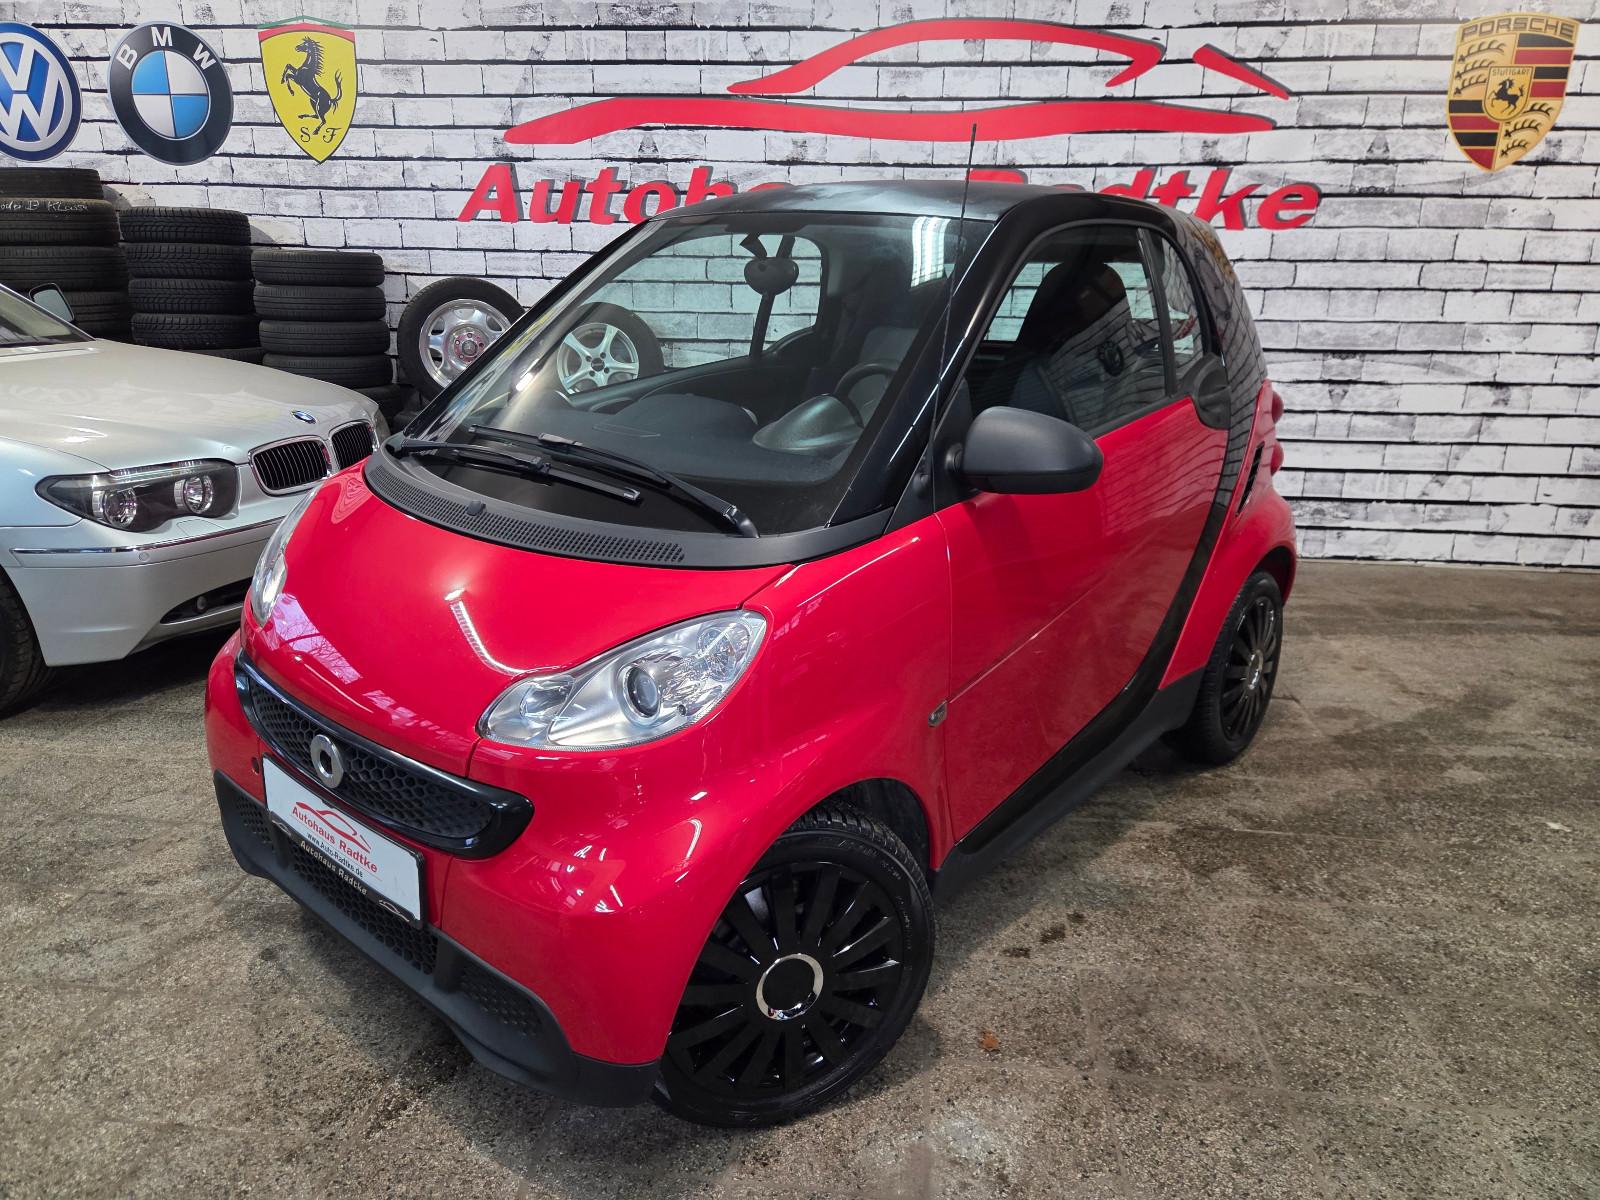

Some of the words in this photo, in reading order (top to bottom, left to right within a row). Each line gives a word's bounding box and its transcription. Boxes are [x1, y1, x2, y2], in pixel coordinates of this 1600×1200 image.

[115, 26, 217, 70] BMW
[1461, 17, 1575, 42] PORSCHE
[1491, 68, 1531, 77] STUTTGART
[292, 806, 336, 844] Autohaus
[339, 840, 378, 873] Radtke
[306, 832, 364, 878] www.Auto-Radtke.de
[300, 840, 337, 872] Autohaus
[338, 868, 368, 895] Radtke
